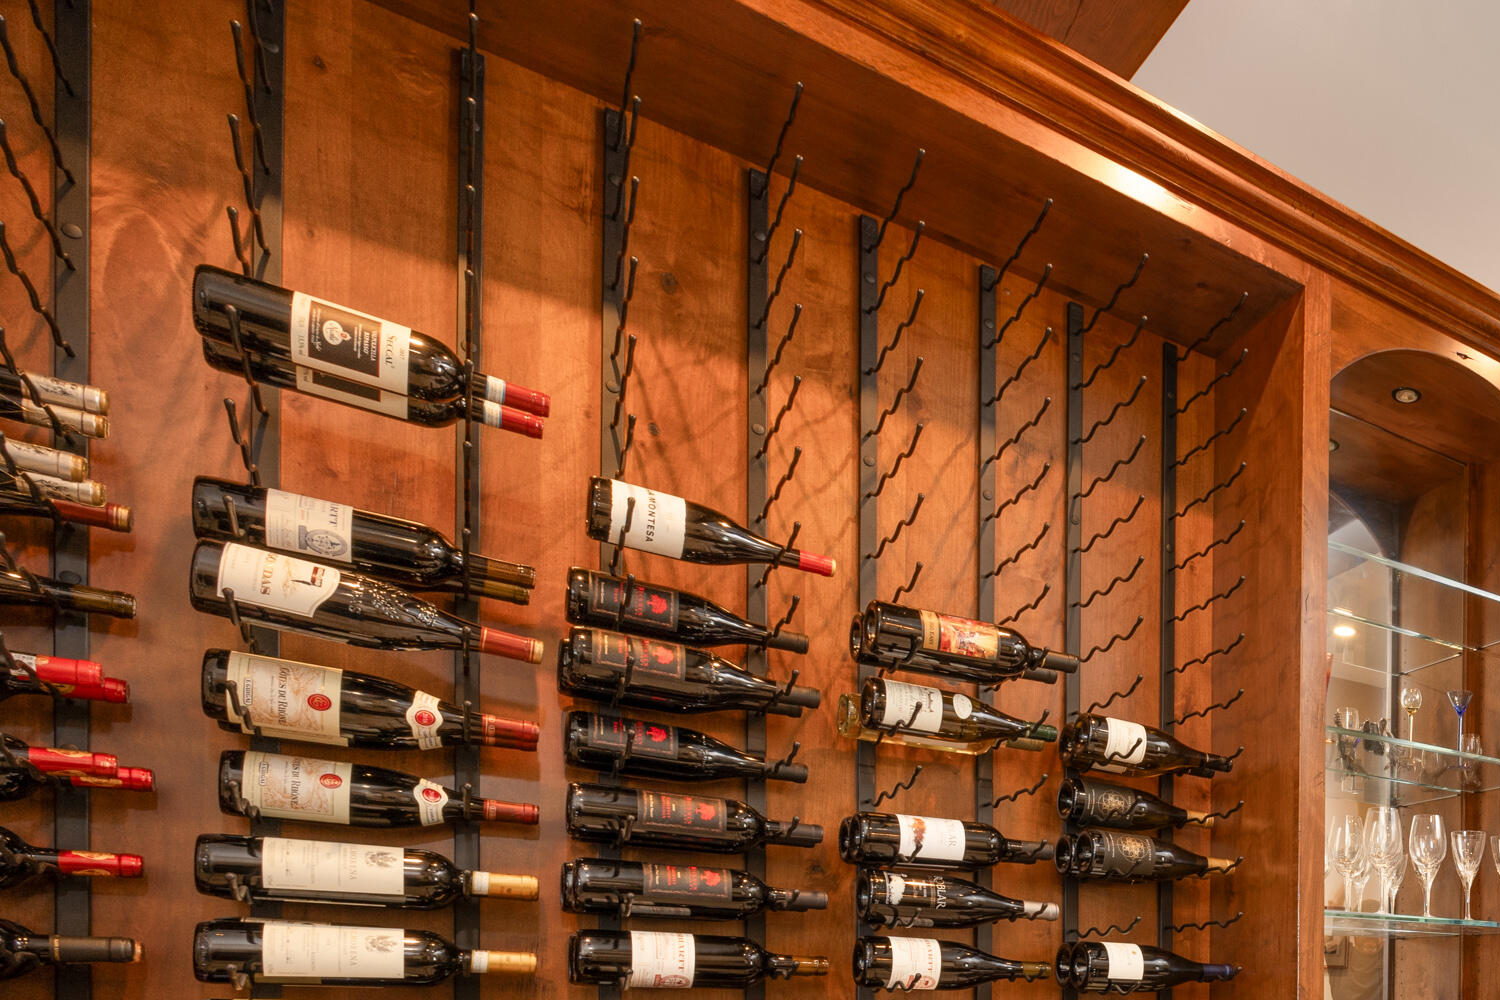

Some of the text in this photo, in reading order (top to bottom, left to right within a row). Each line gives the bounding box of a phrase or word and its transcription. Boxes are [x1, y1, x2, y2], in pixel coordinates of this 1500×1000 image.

[645, 498, 656, 542] MONTESA
[278, 690, 286, 700] DU
[933, 876, 946, 909] ROBLAR
